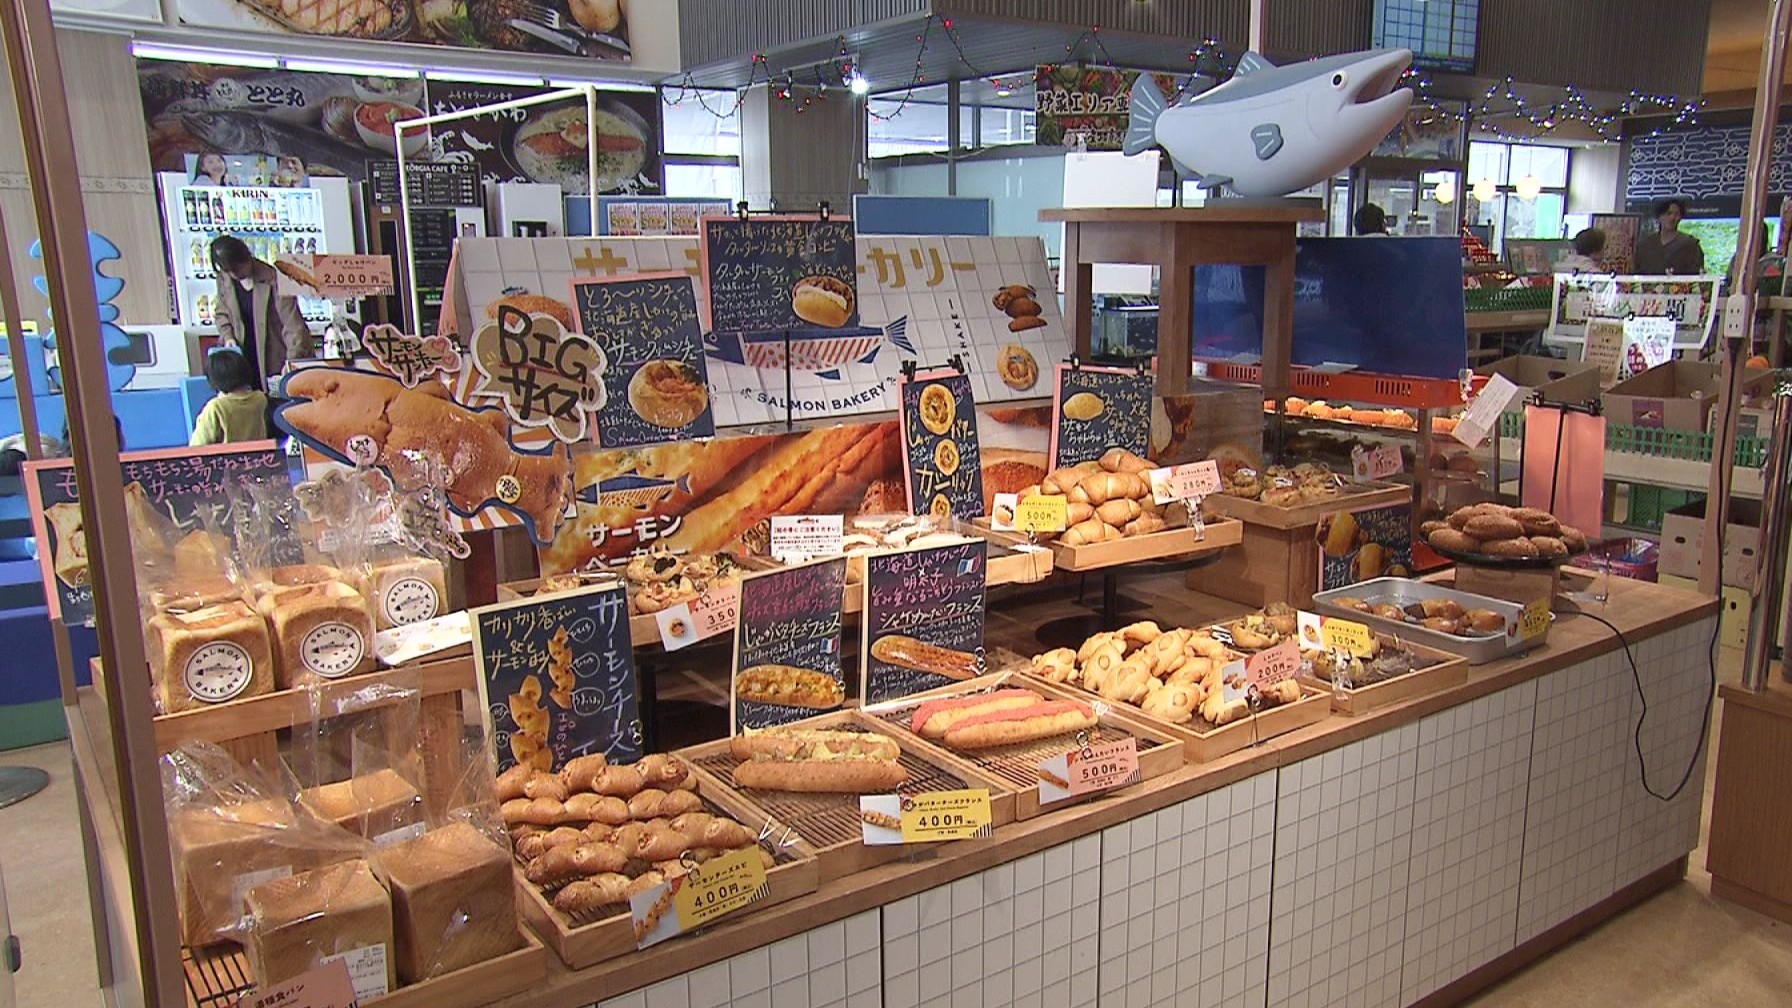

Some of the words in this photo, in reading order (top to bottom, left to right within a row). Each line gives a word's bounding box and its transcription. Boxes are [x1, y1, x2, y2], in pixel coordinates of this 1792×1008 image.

[232, 190, 268, 198] KIRIN
[499, 304, 588, 383] BIG
[499, 367, 595, 420] サイズ
[757, 392, 826, 411] SALMON
[832, 382, 887, 410] BAKERY
[584, 515, 682, 547] サーモン
[708, 608, 735, 625] 350
[310, 628, 352, 643] SALMON
[195, 648, 240, 664] SALMON
[312, 654, 353, 670] BAKERY
[195, 677, 239, 694] BAKERY
[1082, 763, 1117, 779] 500円
[919, 815, 964, 827] 400円
[694, 882, 740, 908] 400円
